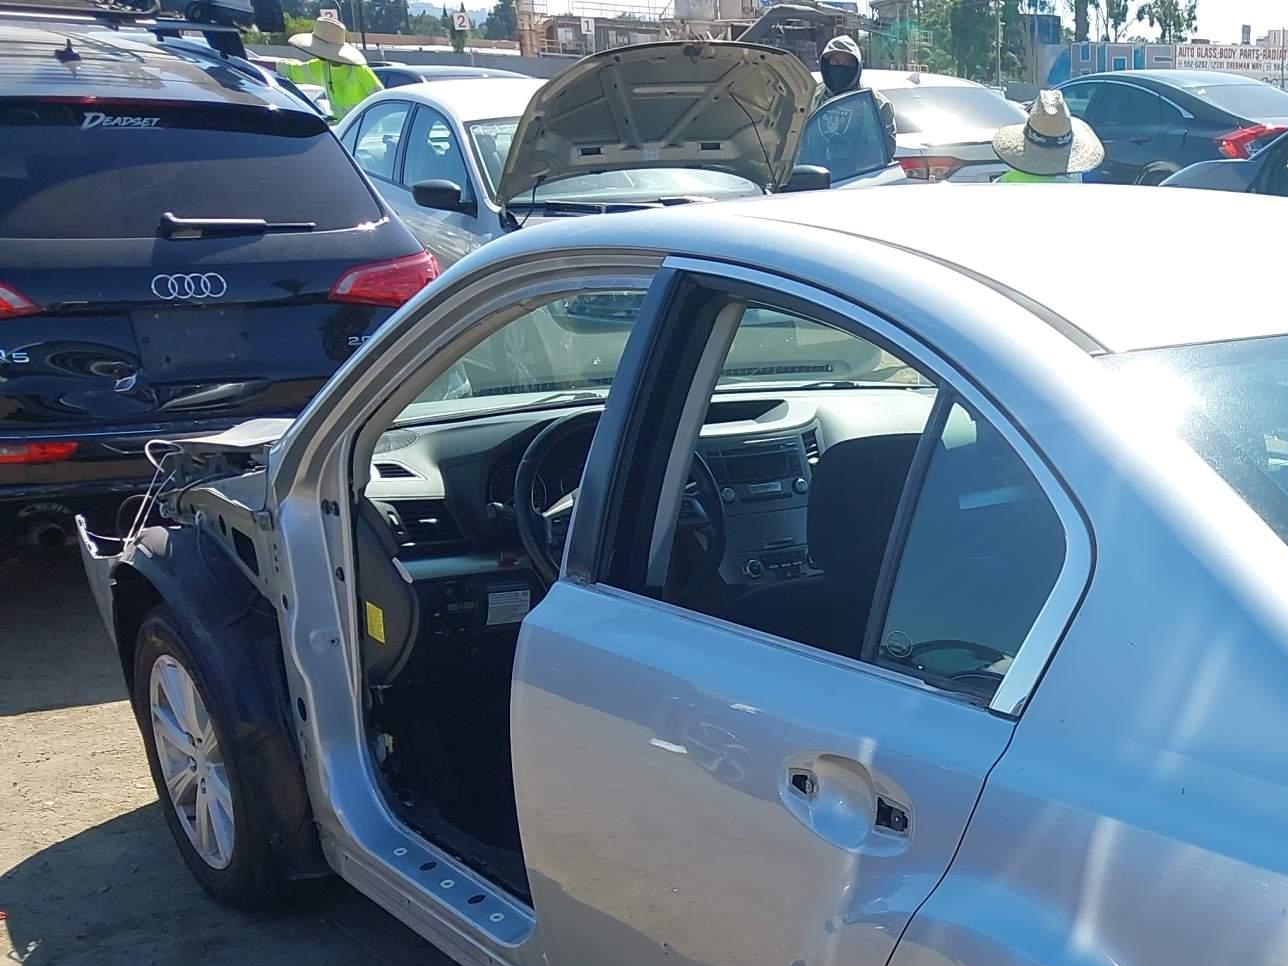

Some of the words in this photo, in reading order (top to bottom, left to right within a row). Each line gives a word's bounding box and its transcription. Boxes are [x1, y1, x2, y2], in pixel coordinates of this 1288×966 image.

[457, 16, 467, 28] 2
[585, 20, 592, 32] 1
[1178, 47, 1195, 58] AUTO
[1226, 61, 1251, 70] SHERMAN
[1251, 62, 1262, 70] WAY
[81, 112, 162, 130] DEADSET
